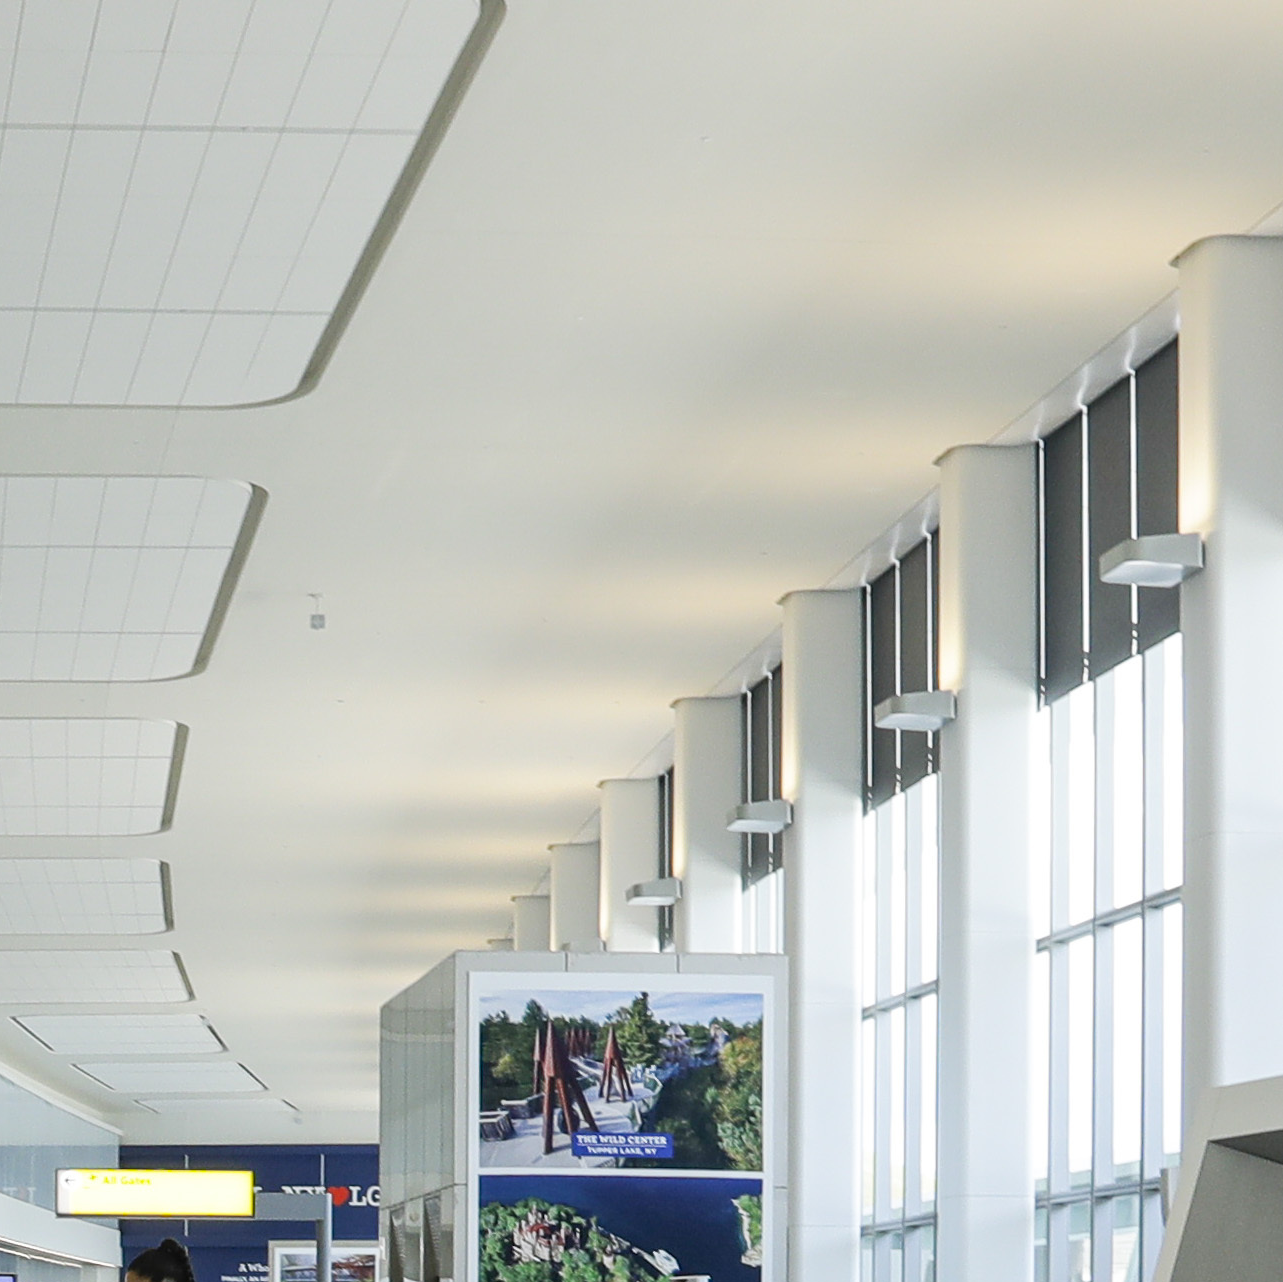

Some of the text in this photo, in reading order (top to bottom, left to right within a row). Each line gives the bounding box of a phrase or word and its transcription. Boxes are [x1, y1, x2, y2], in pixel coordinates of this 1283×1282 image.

[576, 1134, 667, 1145] THE WILD CENTER
